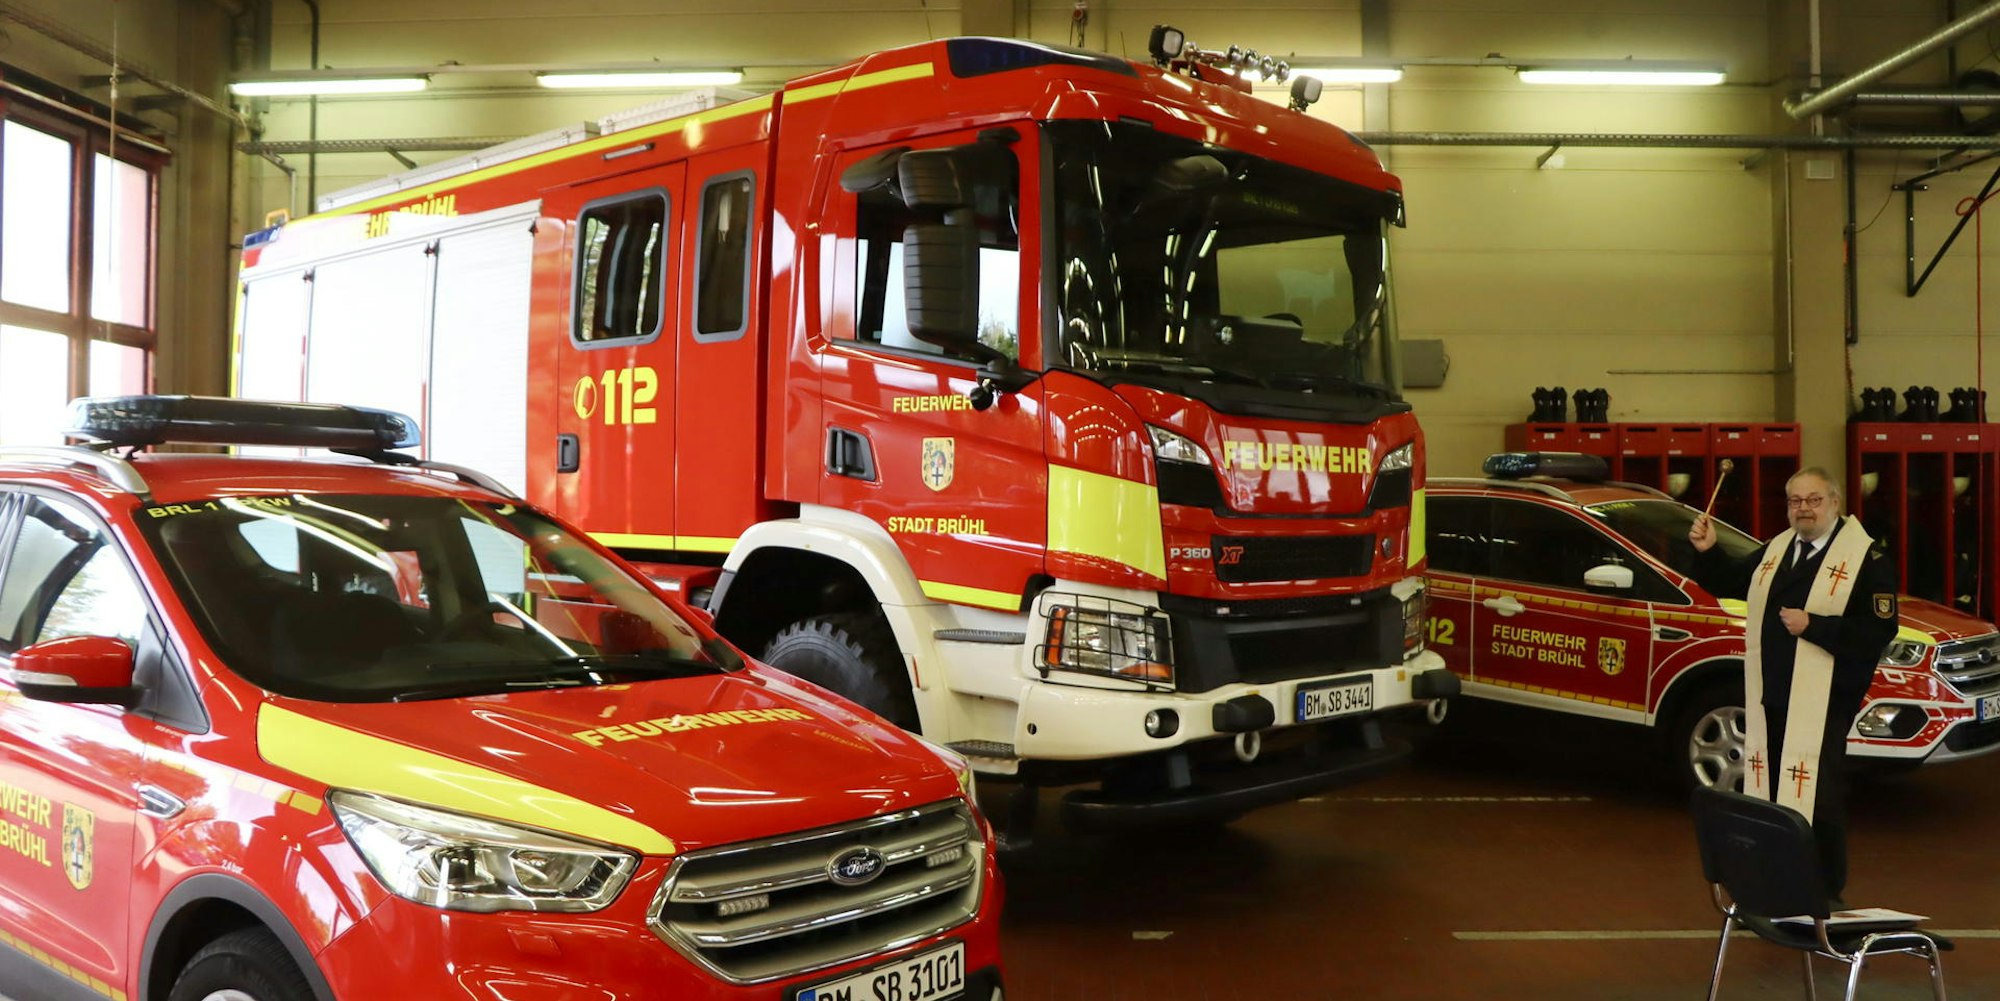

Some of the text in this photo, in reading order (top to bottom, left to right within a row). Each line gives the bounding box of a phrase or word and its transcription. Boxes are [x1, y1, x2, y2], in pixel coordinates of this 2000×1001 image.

[601, 367, 658, 425] 112
[893, 395, 973, 413] FEUERWEH
[1223, 440, 1373, 474] FEUERWEHR
[147, 504, 203, 518] BRL
[205, 501, 219, 511] 1
[888, 515, 990, 535] STADT BRÜHL
[1170, 547, 1212, 559] P 360
[1219, 546, 1244, 564] XT
[1424, 616, 1455, 645] 12
[1492, 624, 1587, 651] FEUERWEHR
[1491, 641, 1586, 668] STADT BRÜHL
[1306, 686, 1370, 716] BM SB 3441
[572, 707, 815, 748] FEUERWEHR
[0, 781, 52, 830] WEHR
[0, 818, 53, 867] BRÜHL
[872, 970, 902, 1001] SB
[908, 950, 962, 1001] 3101
